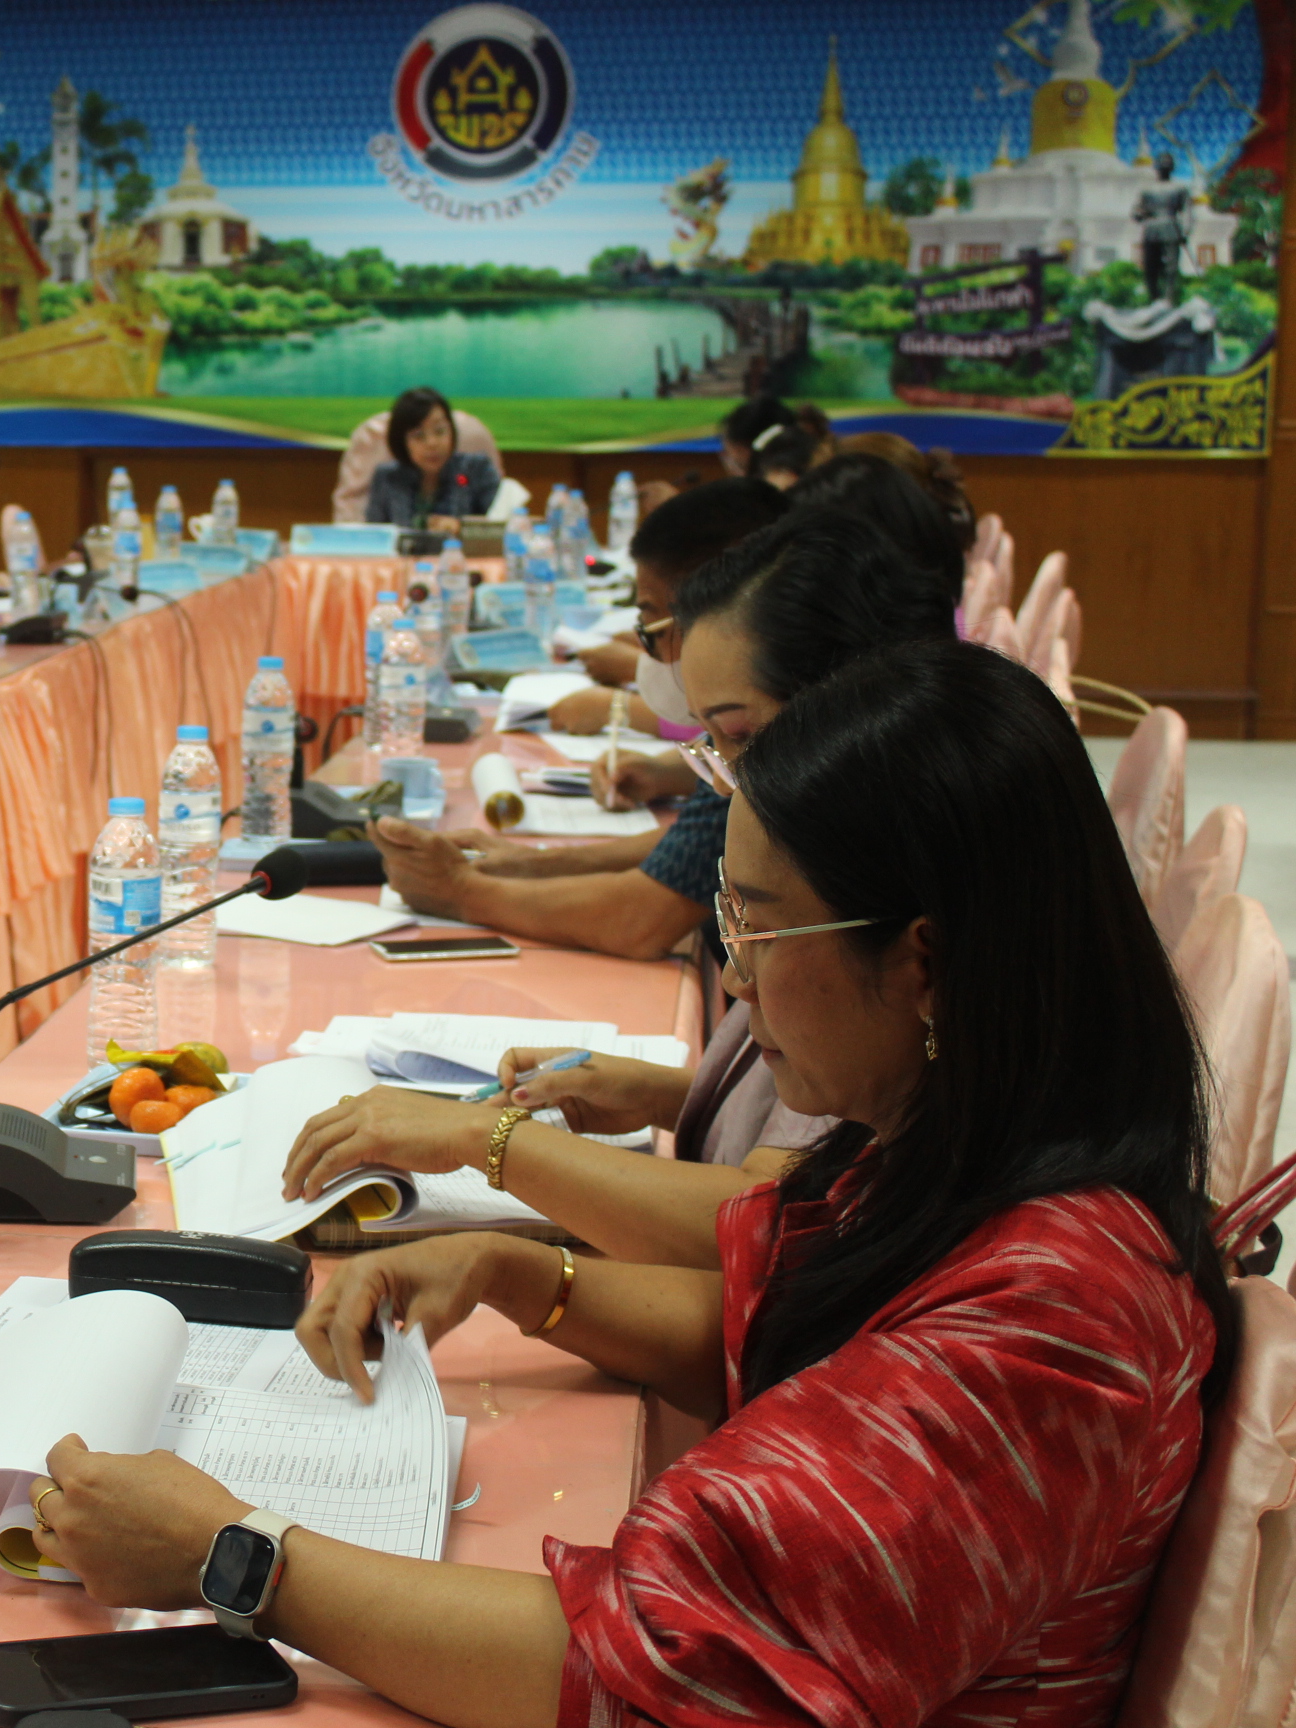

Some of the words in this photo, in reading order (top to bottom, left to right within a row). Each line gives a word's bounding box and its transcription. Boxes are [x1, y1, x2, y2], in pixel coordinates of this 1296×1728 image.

[368, 132, 600, 221] จังหวัดมหาสารคาม
